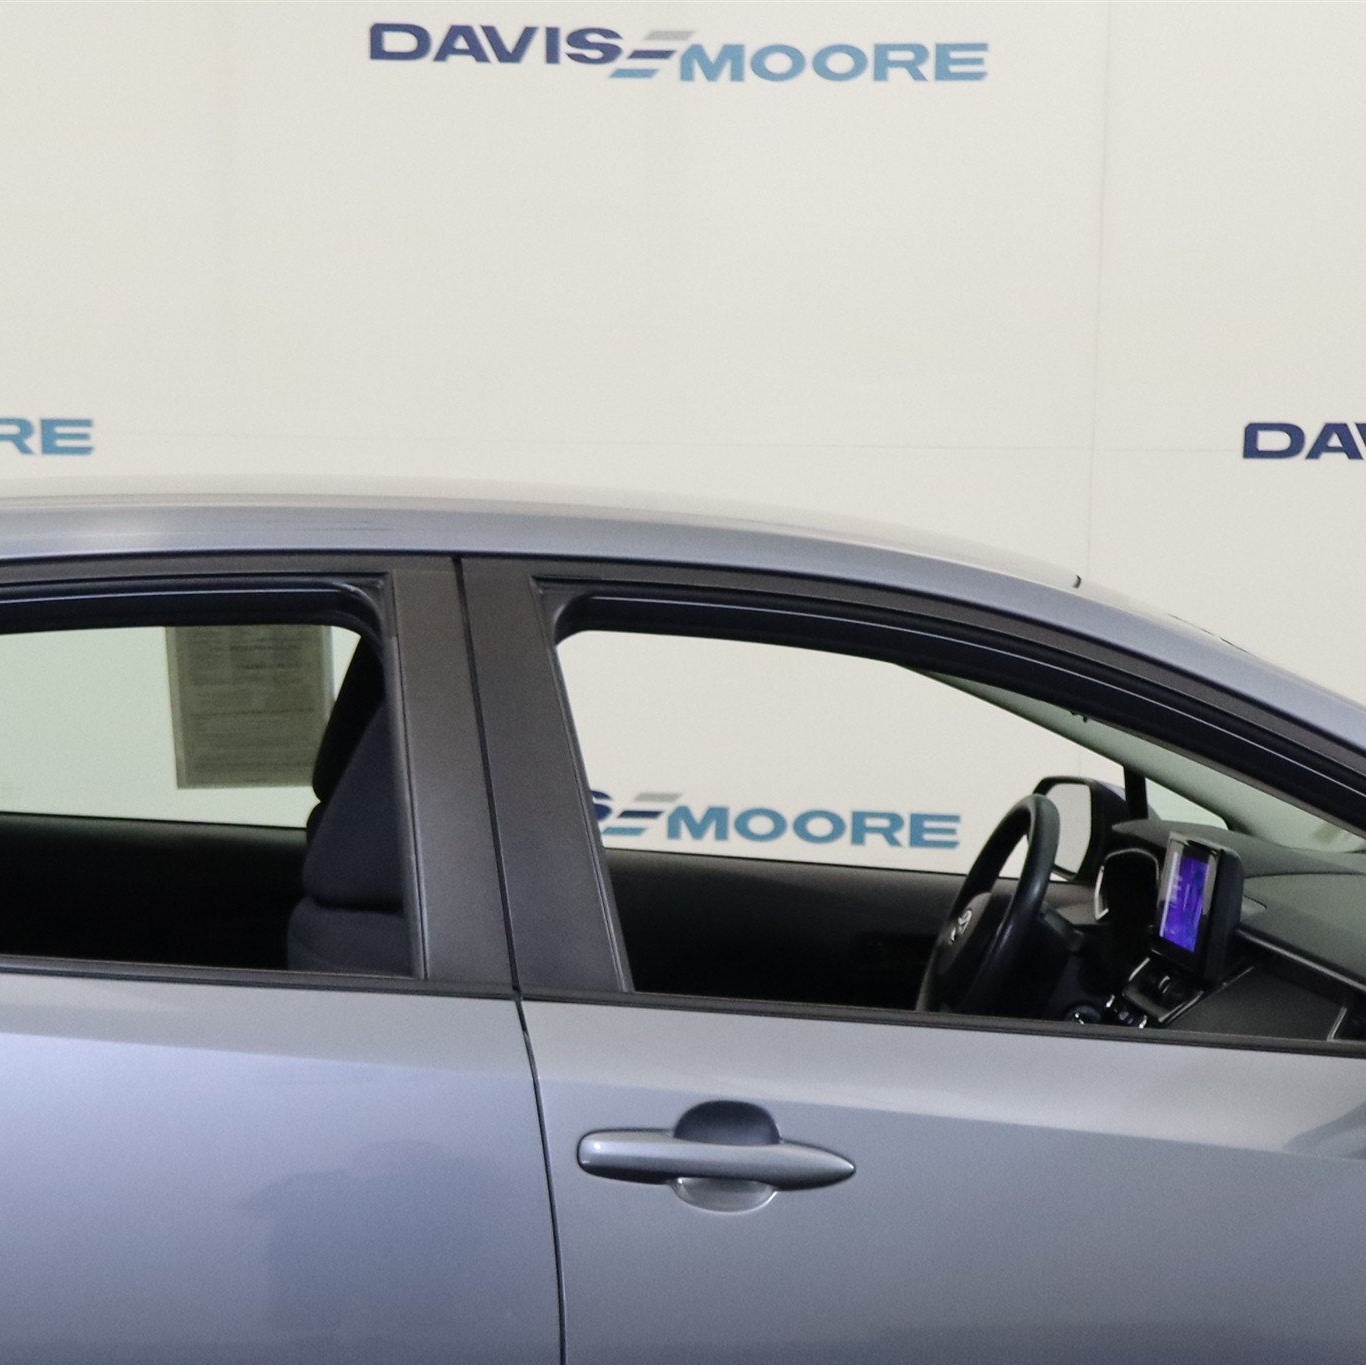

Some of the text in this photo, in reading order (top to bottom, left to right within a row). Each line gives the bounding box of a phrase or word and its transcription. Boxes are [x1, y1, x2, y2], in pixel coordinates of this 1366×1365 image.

[369, 22, 990, 83] DAVIS MOORE
[667, 805, 962, 850] MOORE
